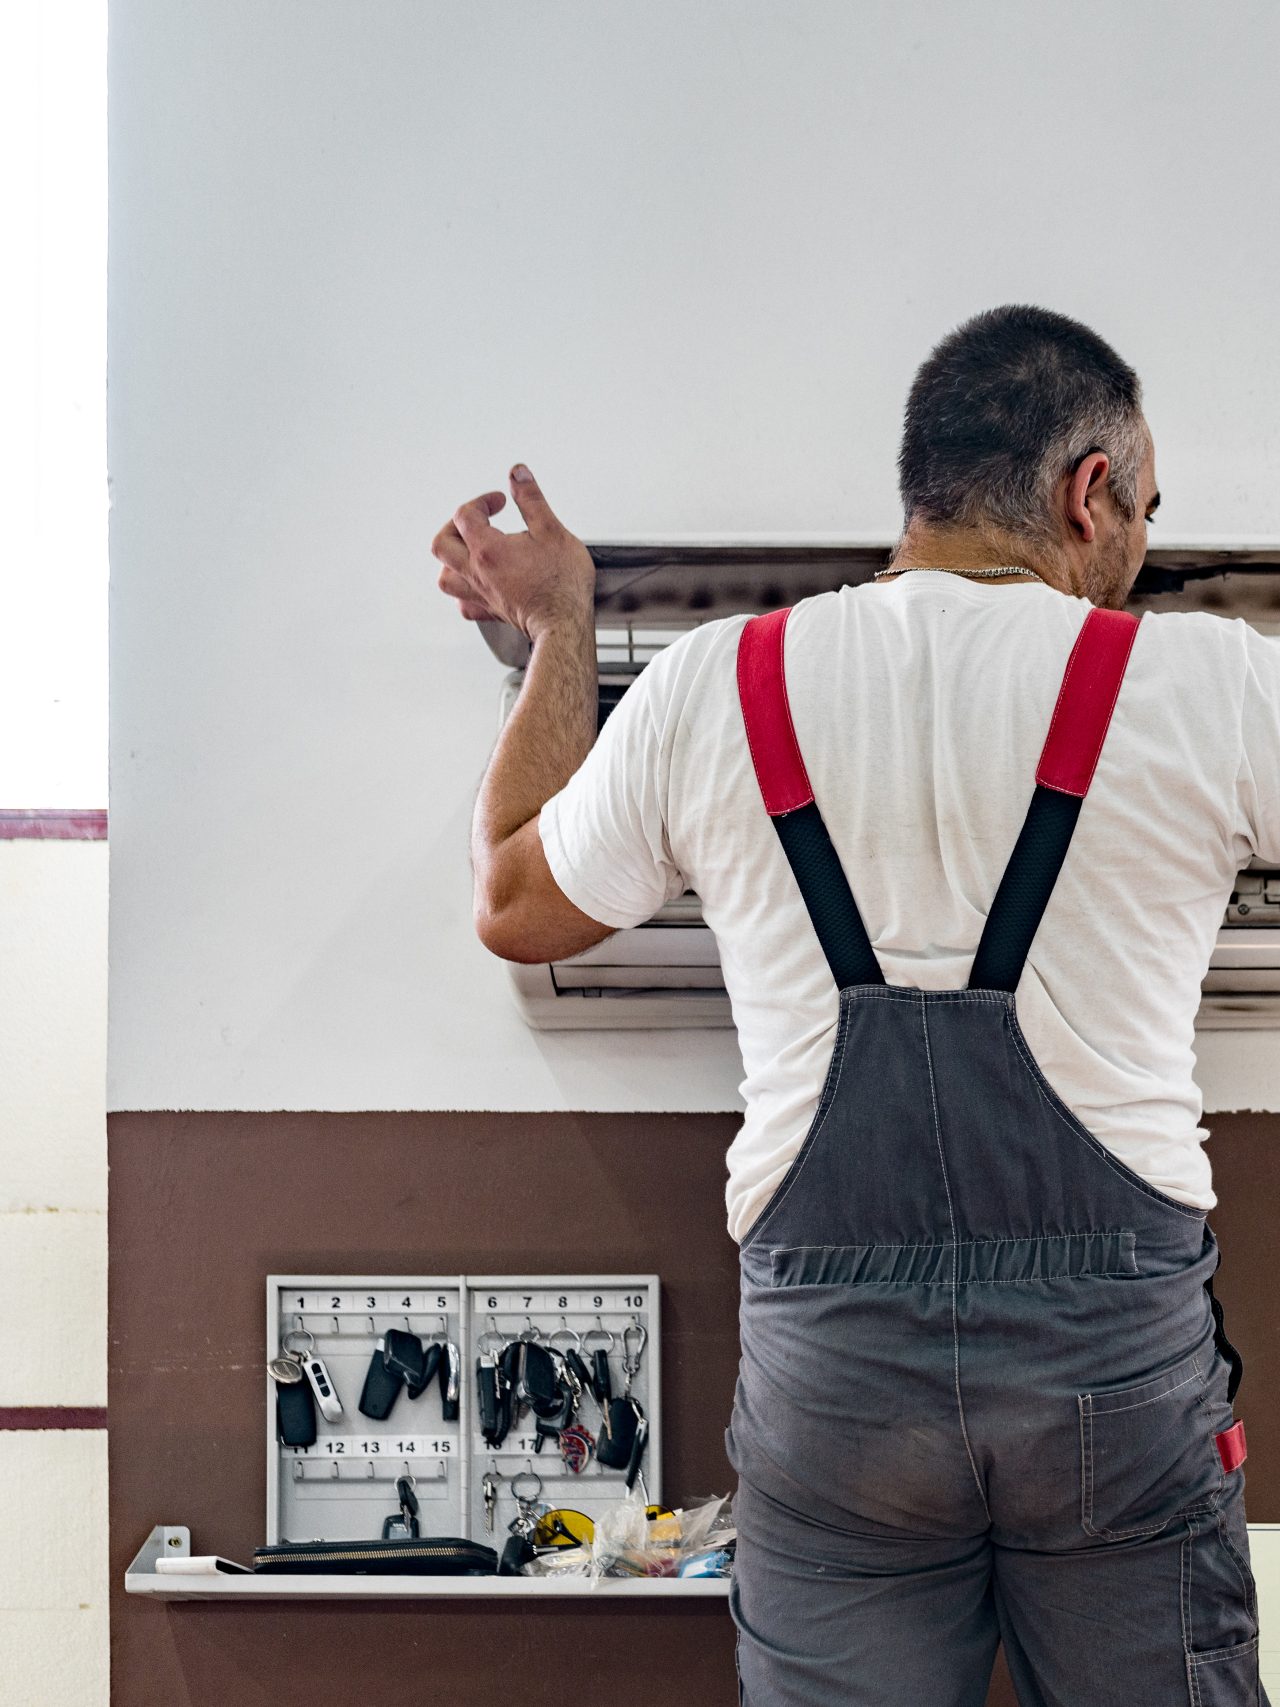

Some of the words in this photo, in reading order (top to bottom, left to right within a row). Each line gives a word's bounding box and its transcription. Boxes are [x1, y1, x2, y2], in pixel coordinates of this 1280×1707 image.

[297, 1297, 304, 1309] 1
[331, 1297, 341, 1308] 2
[367, 1297, 376, 1308] 3
[401, 1297, 411, 1308] 4
[437, 1297, 446, 1308] 5
[488, 1297, 497, 1308] 6
[522, 1297, 532, 1308] 7
[558, 1297, 568, 1308] 8
[593, 1297, 603, 1308] 9
[624, 1296, 643, 1307] 10
[325, 1442, 345, 1453] 12
[361, 1442, 380, 1453] 13
[396, 1442, 415, 1453] 14
[431, 1441, 451, 1453] 15
[518, 1438, 537, 1450] 17
